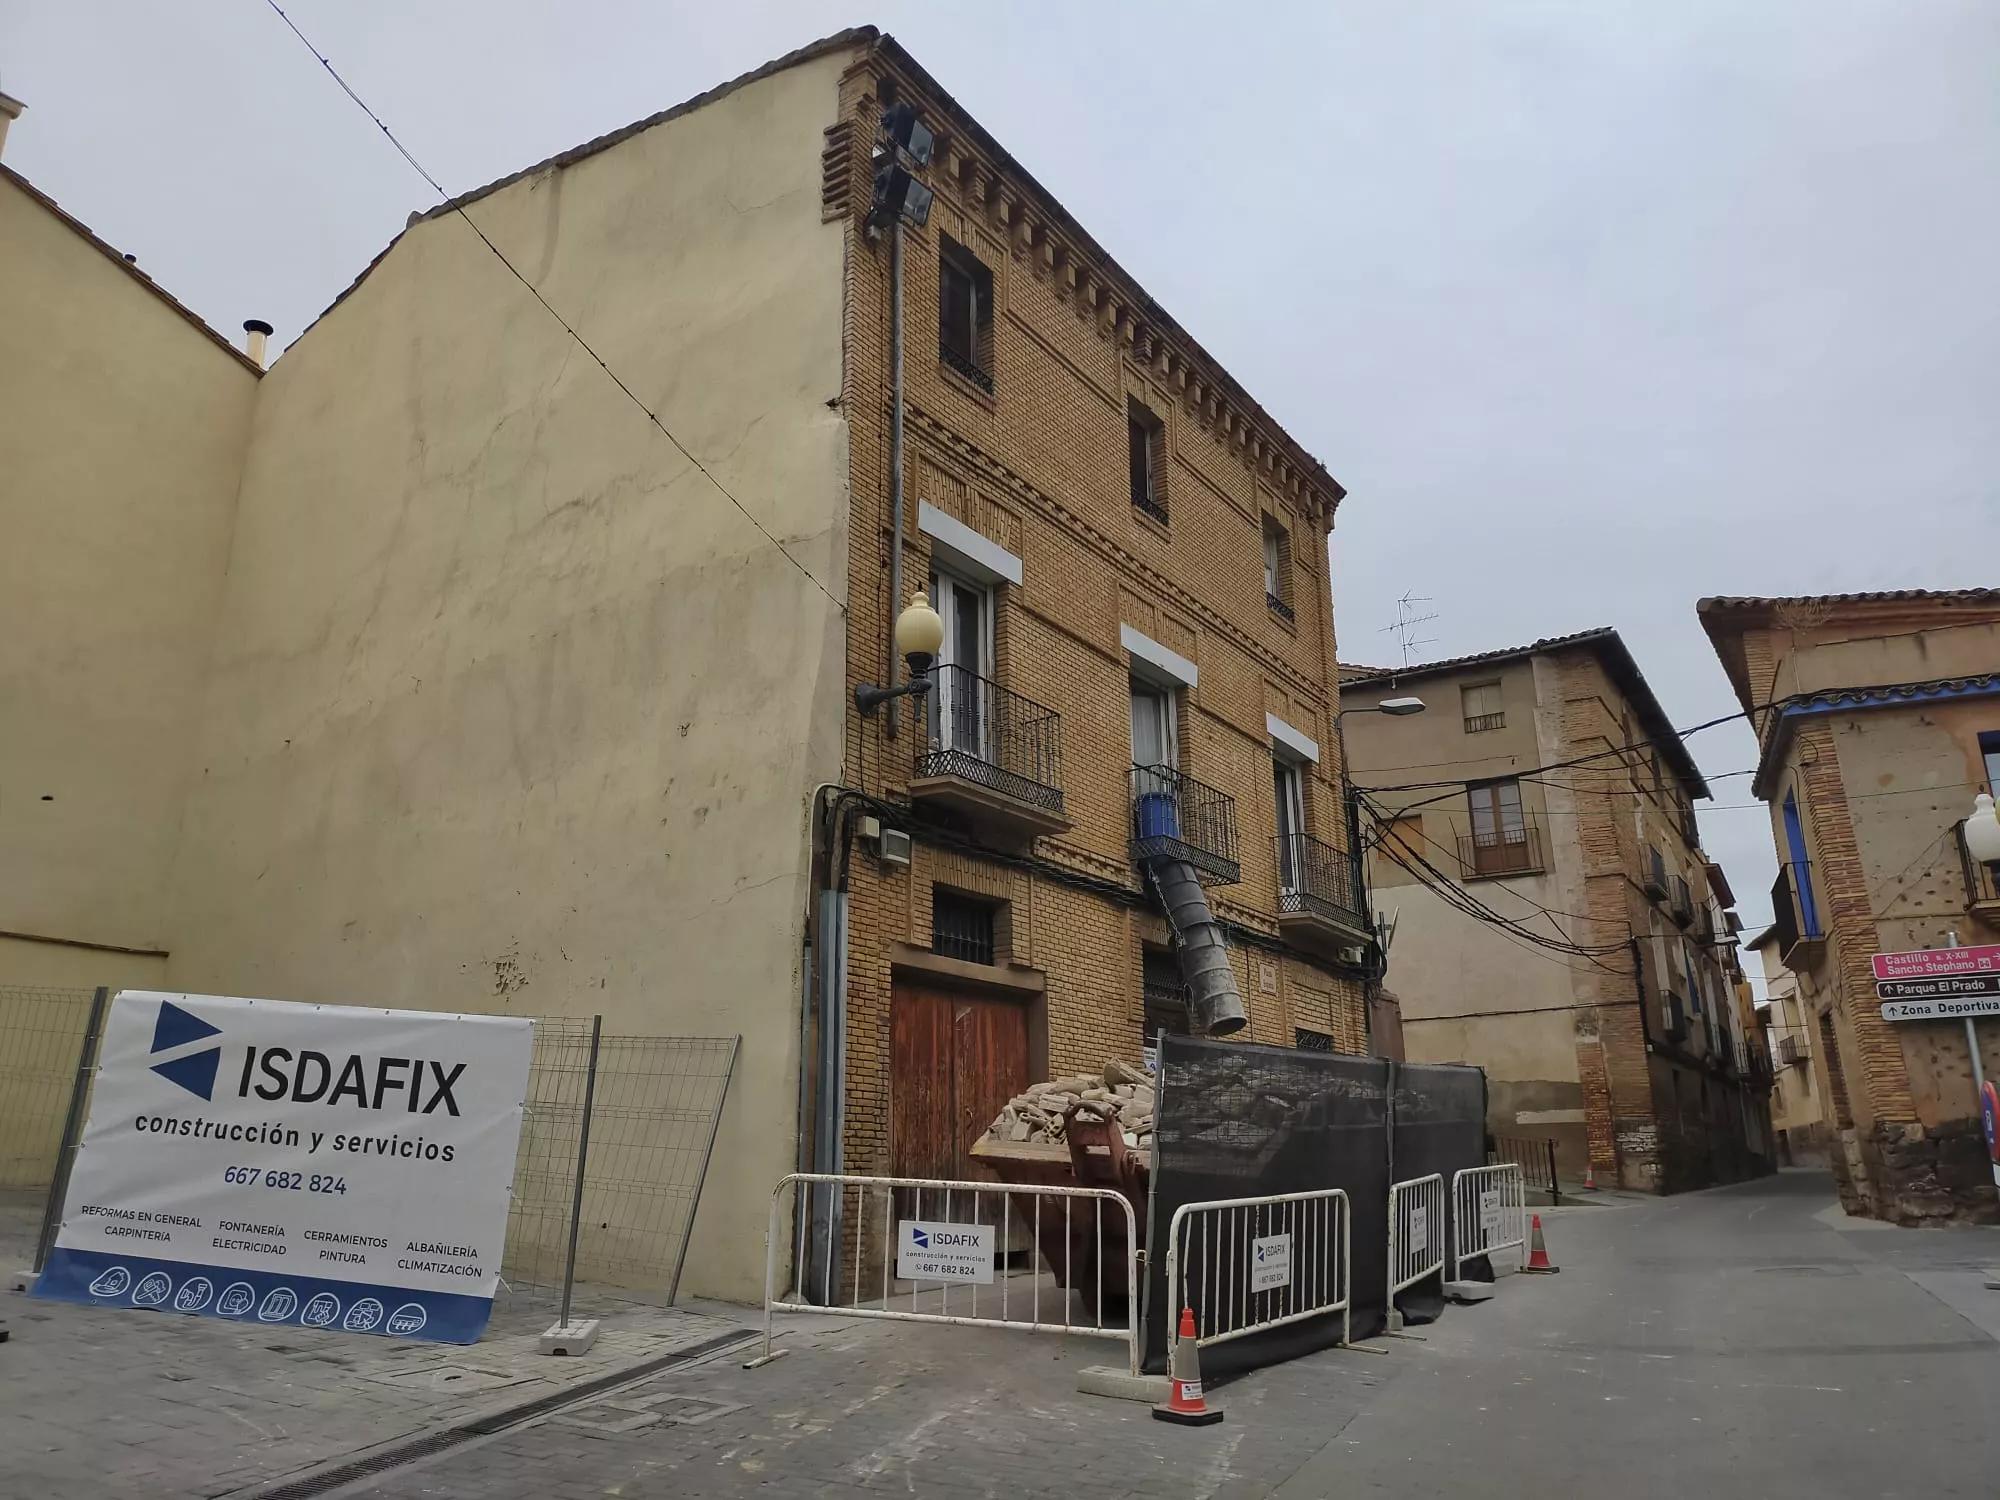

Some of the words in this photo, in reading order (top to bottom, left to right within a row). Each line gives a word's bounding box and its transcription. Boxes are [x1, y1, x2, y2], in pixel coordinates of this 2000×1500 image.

[1885, 954, 1929, 965] Castillo
[1887, 964, 1923, 975] Sancto
[1926, 961, 1975, 973] Stephano
[1896, 983, 1936, 995] Parque
[1938, 981, 1950, 992] El
[1952, 980, 1985, 991] Prado
[1901, 1005, 1931, 1015] Zona
[1938, 1001, 2000, 1014] Deportiva
[238, 1046, 468, 1117] ISDAFIX
[135, 1115, 299, 1146] construcción
[308, 1131, 324, 1153] y
[332, 1134, 456, 1162] servicios
[224, 1166, 261, 1186] 667
[265, 1170, 302, 1190] 682
[309, 1174, 347, 1195] 824
[81, 1205, 135, 1220] REFORMAS
[138, 1211, 152, 1222] EN
[154, 1213, 202, 1228] GENERAL
[219, 1220, 286, 1237] FONTANERÍA
[212, 1238, 287, 1255] ELECTRICIDAD
[304, 1230, 388, 1248] CERRAMIENTOS
[933, 1233, 980, 1247] ISDAFIX
[319, 1250, 366, 1264] PINTURA
[406, 1241, 478, 1258] ALBAÑILERÍA
[906, 1251, 948, 1259] construcción
[397, 1259, 482, 1277] CLIMATIZACIÓN
[923, 1264, 938, 1273] 667
[941, 1264, 957, 1274] 682
[959, 1266, 975, 1275] 824
